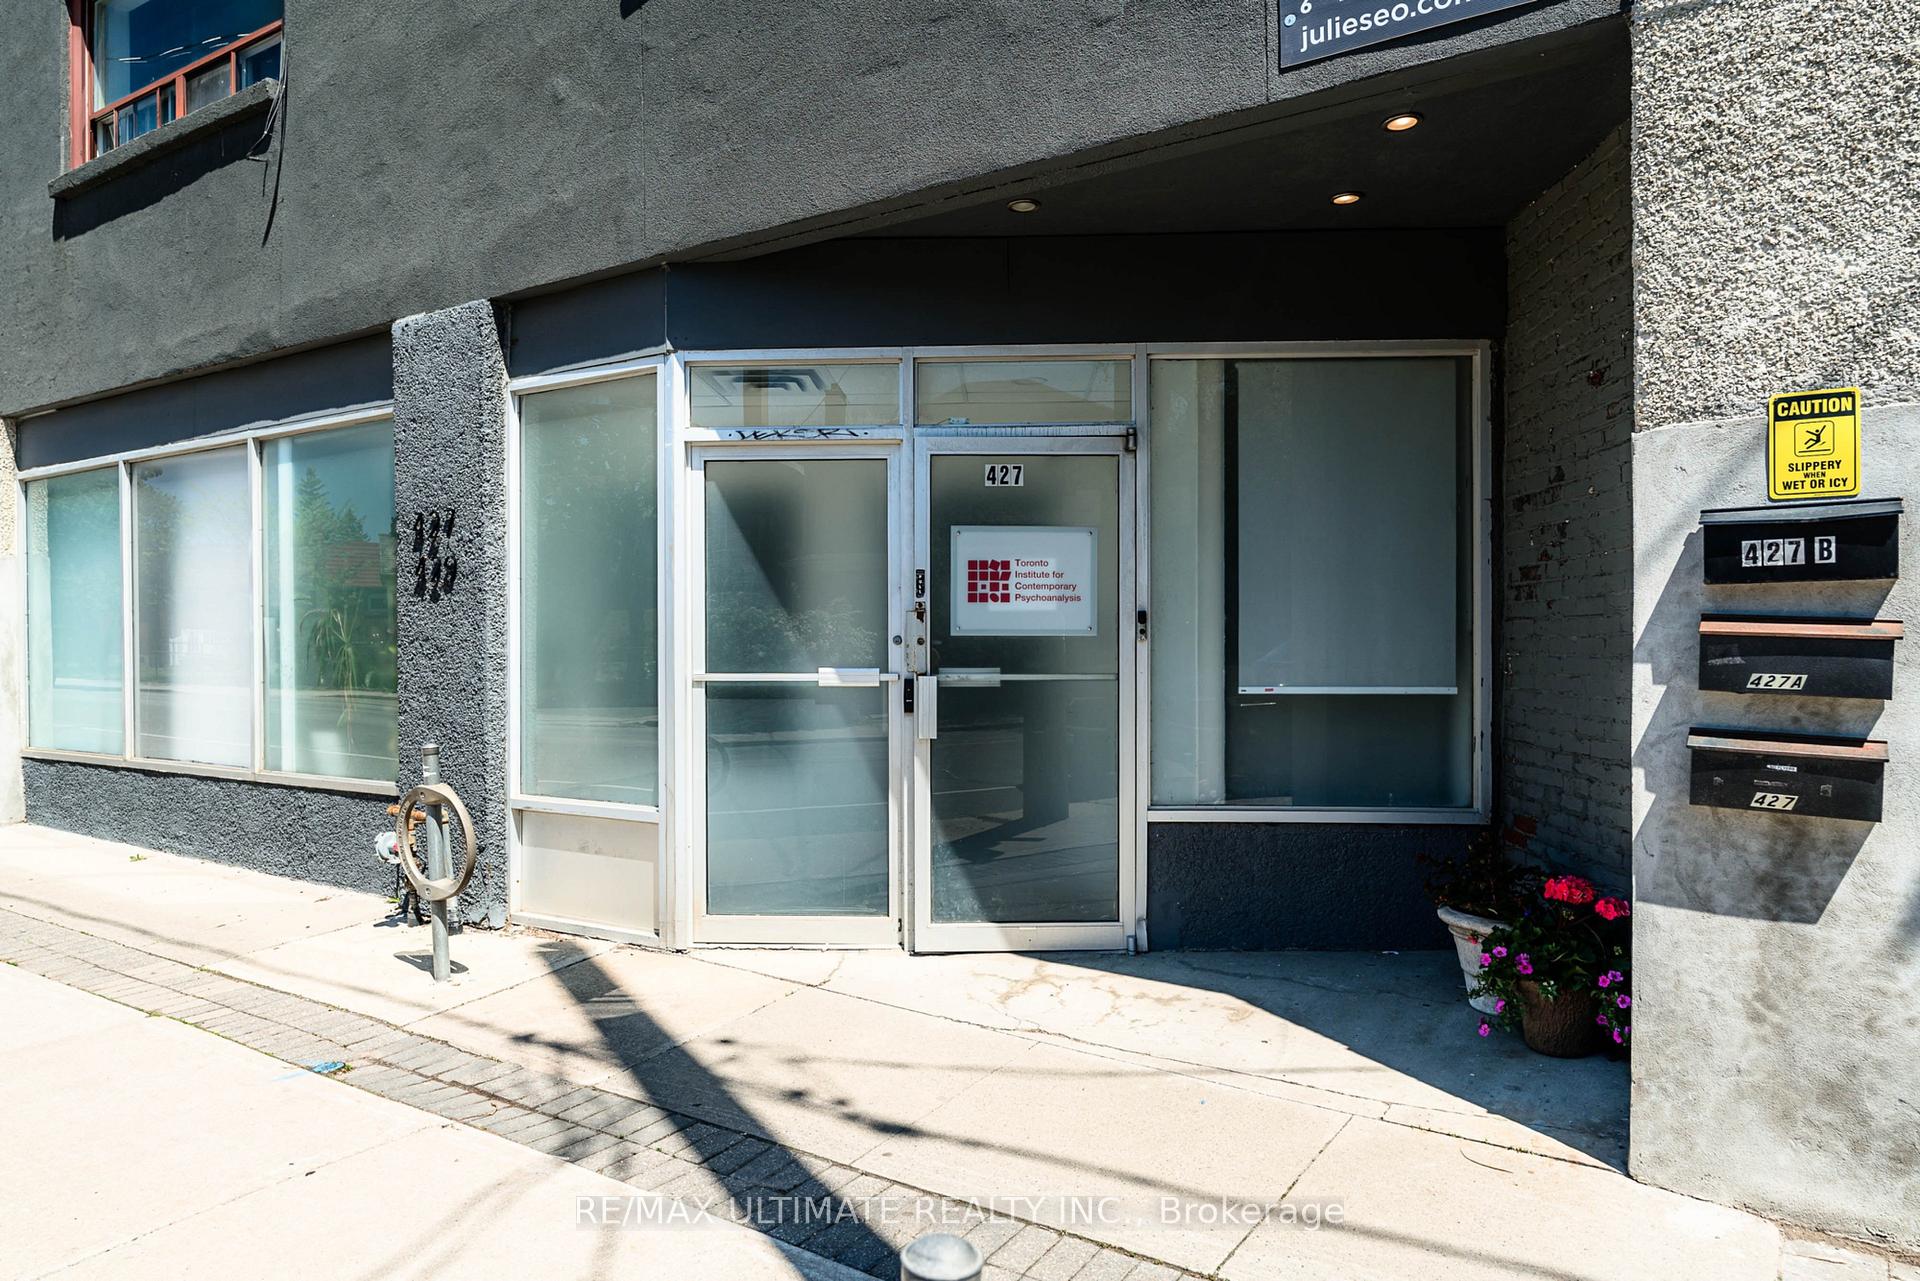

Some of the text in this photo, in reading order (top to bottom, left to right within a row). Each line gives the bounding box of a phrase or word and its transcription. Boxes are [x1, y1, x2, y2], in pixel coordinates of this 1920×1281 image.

[1300, 0, 1473, 52] julieseo.co
[1777, 397, 1852, 416] CAUTION
[1788, 460, 1842, 472] SLIPPERY
[986, 465, 1022, 485] 427
[1803, 471, 1826, 479] WHEN
[1782, 477, 1848, 490] WET OR ICY
[1744, 538, 1833, 565] 427 B
[1015, 559, 1049, 567] Toronto
[1015, 571, 1064, 579] Institute for
[1015, 582, 1077, 592] Contemporary
[1015, 593, 1081, 603] Psychoanalysis
[1750, 675, 1803, 688] 427A
[1754, 794, 1796, 808] 427
